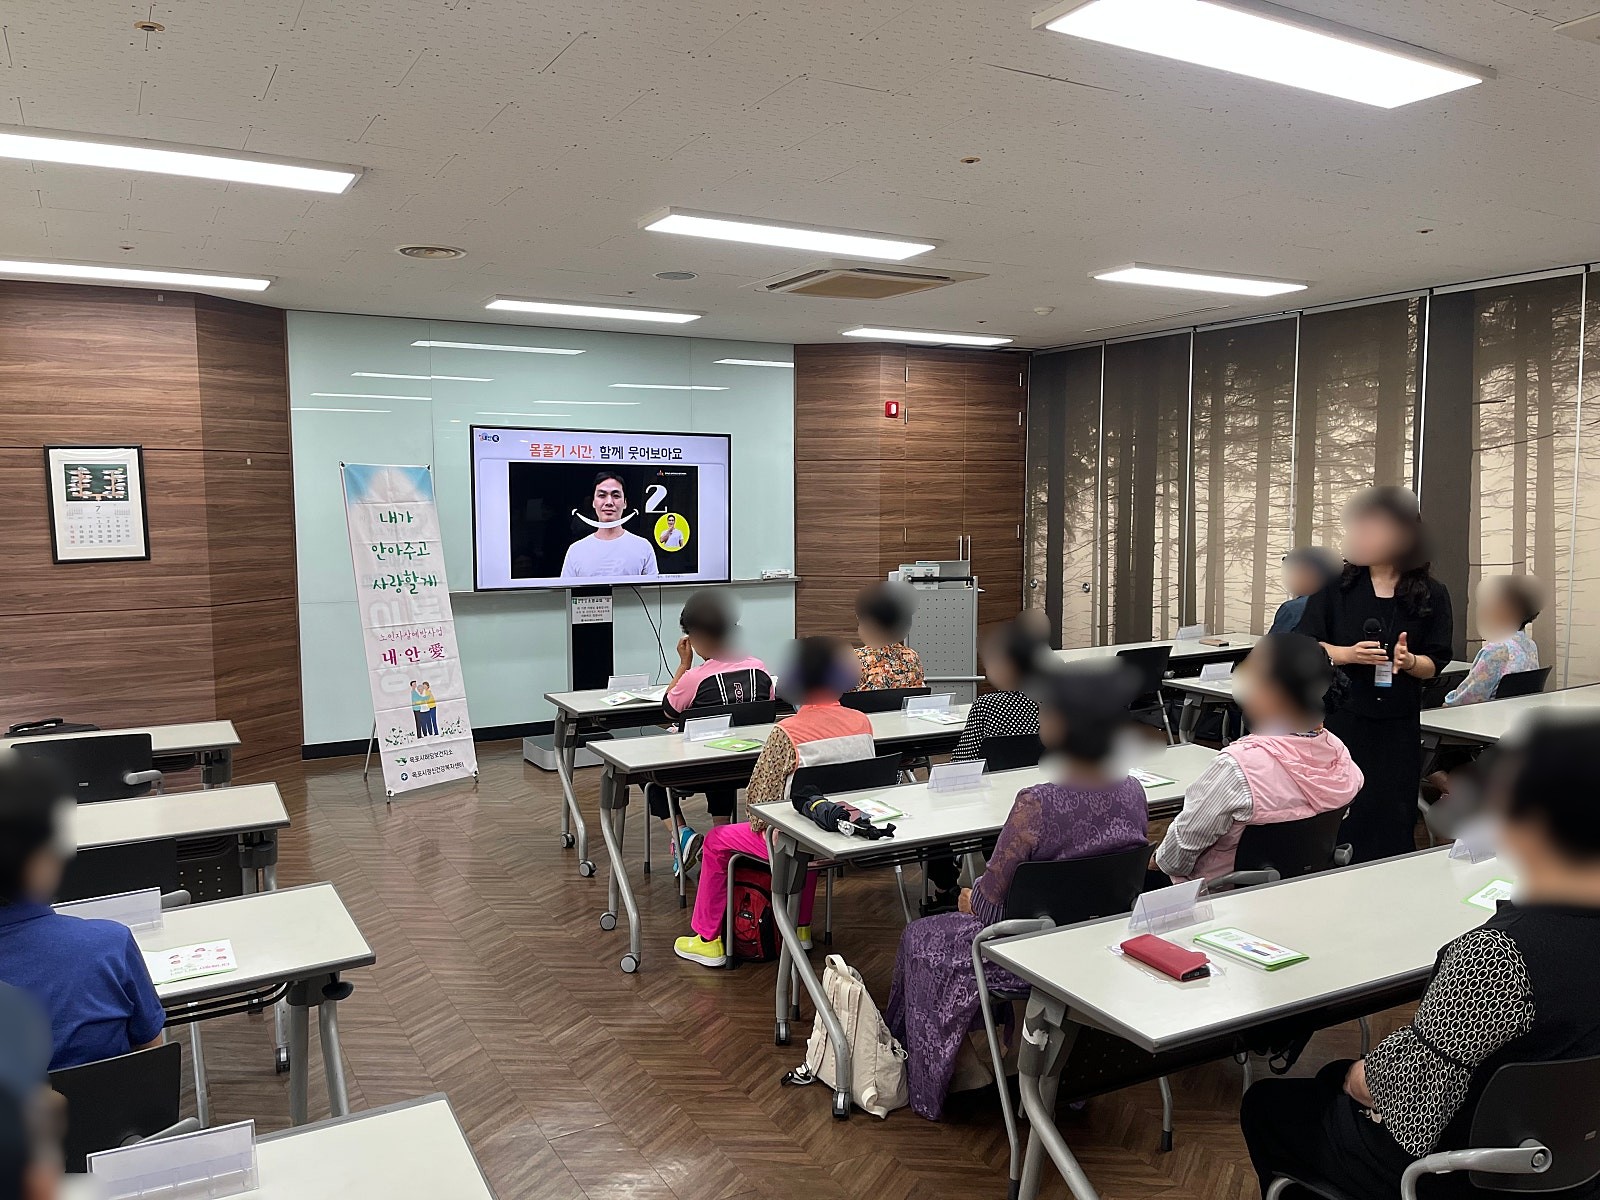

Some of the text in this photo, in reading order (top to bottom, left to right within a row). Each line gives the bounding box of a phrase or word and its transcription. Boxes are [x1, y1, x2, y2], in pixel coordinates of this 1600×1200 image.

[529, 443, 565, 458] 몸풀기
[599, 445, 624, 460] 함께
[628, 446, 683, 461] 웃어보아요
[645, 484, 668, 513] 2
[379, 511, 414, 524] 내가
[371, 541, 431, 561] 안아주고
[372, 569, 438, 595] 사랑할게
[379, 626, 443, 642] 노인자살예방사업
